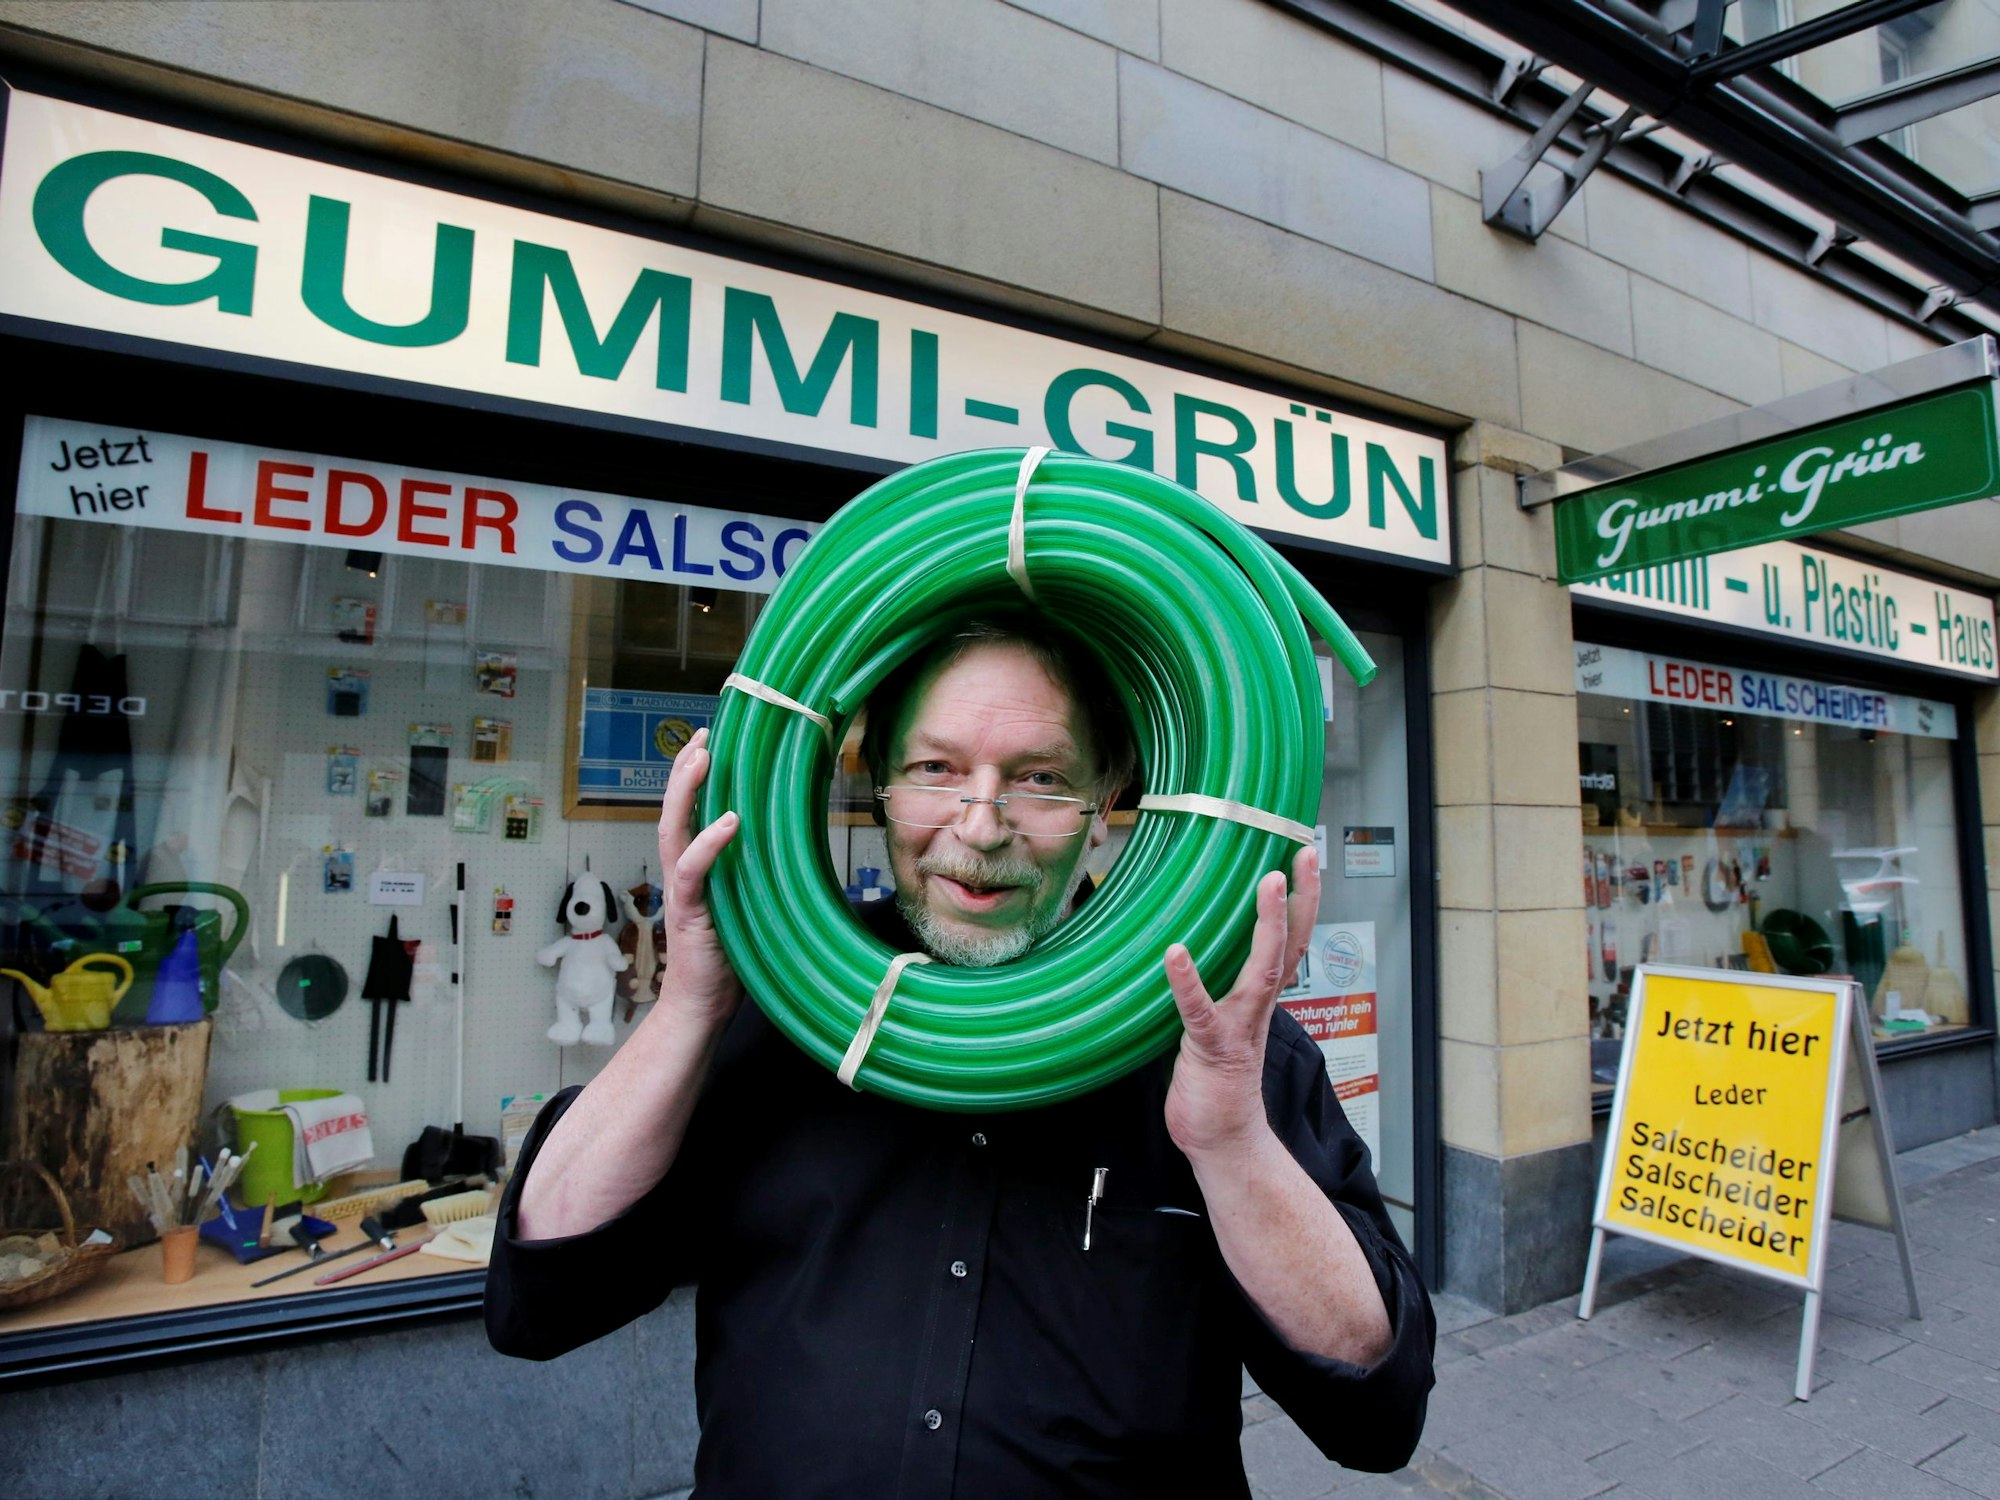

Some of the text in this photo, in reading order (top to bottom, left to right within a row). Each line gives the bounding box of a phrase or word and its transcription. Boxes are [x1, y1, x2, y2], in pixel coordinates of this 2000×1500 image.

[32, 150, 1439, 541] GUMMI-GRÜN
[50, 434, 153, 473] Jetzt
[69, 480, 150, 516] hier
[185, 451, 519, 554] LEDER
[1597, 433, 1925, 568] Gummi-Grün
[1762, 563, 1792, 628] u.
[1801, 555, 1899, 651] Plastic
[1935, 591, 1993, 671] Haus
[1649, 659, 1888, 726] LEDER SALSCHEIDER
[1325, 1018, 1359, 1033] runter
[1350, 1001, 1372, 1015] rein
[1657, 1010, 1819, 1057] Jetzt hier
[1695, 1084, 1767, 1106] Leder
[1631, 1122, 1811, 1182] Salscheider
[1626, 1155, 1808, 1219] Salscheider
[1620, 1187, 1804, 1257] Salscheider
